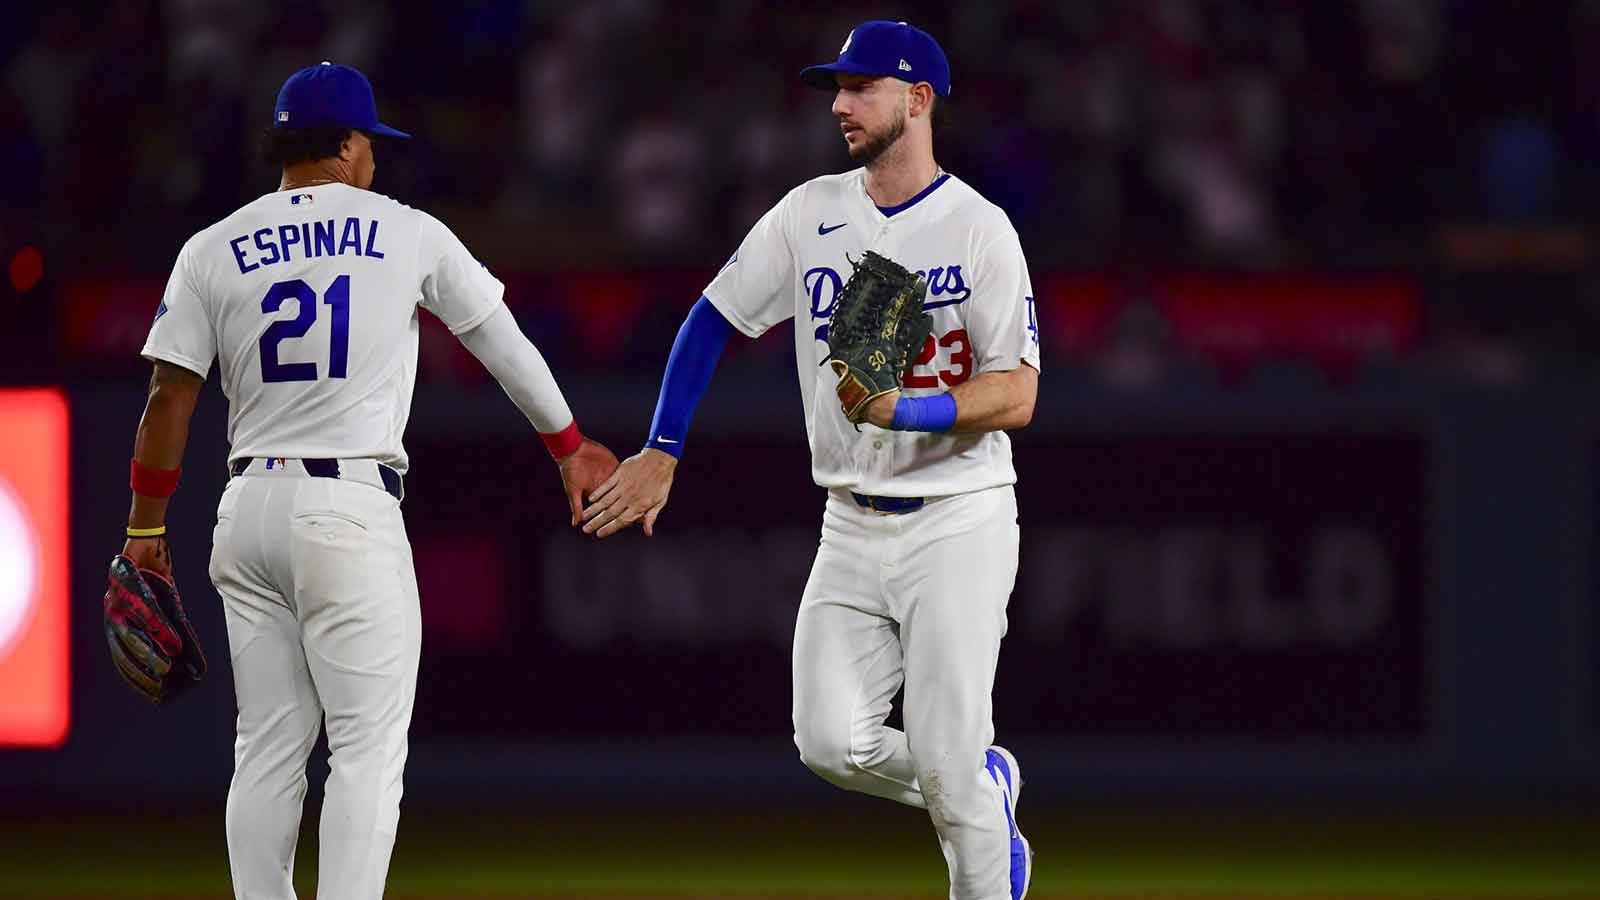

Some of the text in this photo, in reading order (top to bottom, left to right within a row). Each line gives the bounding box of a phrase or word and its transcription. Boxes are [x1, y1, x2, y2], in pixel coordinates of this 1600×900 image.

[229, 217, 385, 274] ESPINAL
[259, 275, 350, 382] 21
[868, 350, 887, 372] 30
[903, 328, 973, 388] 23
